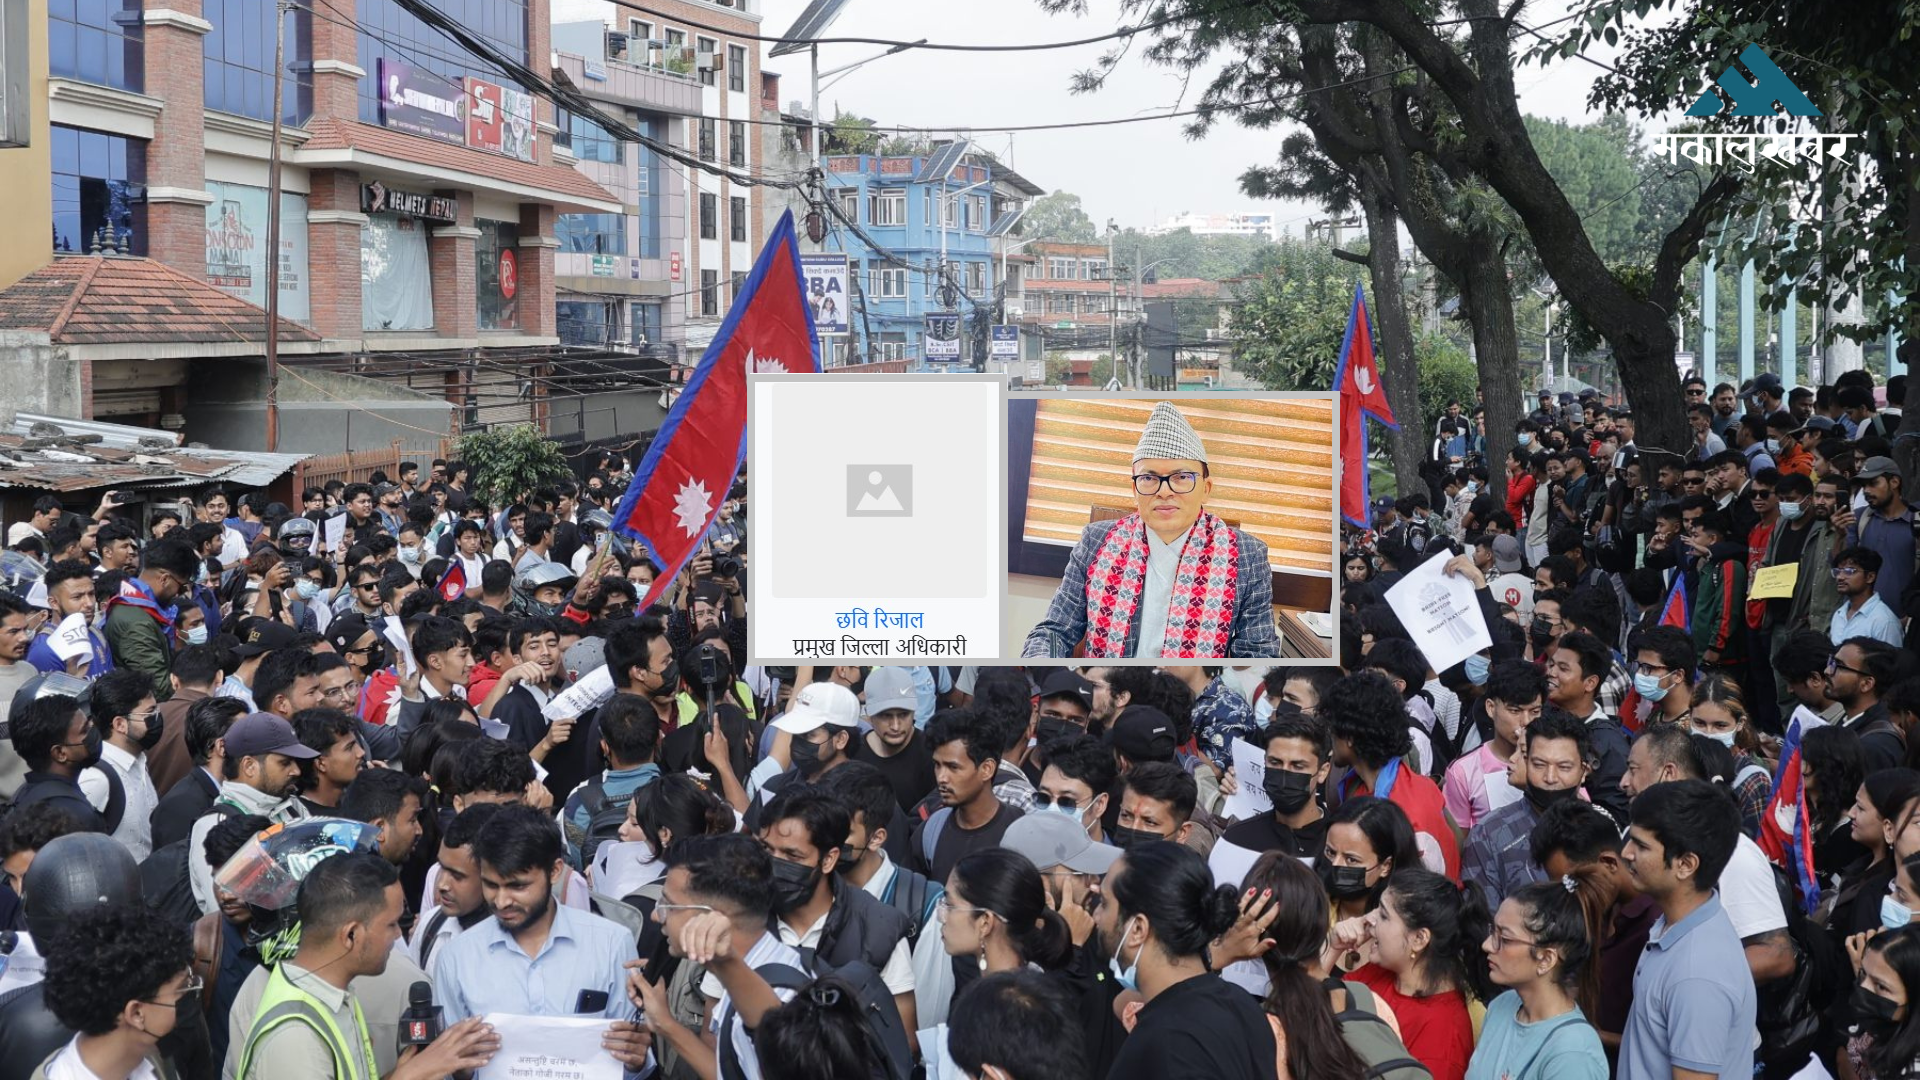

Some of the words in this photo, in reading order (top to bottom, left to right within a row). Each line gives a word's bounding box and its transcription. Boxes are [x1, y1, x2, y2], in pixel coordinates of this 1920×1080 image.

[389, 191, 427, 214] HELMETS
[430, 196, 453, 219] NEPAL
[206, 228, 254, 252] ONSOON
